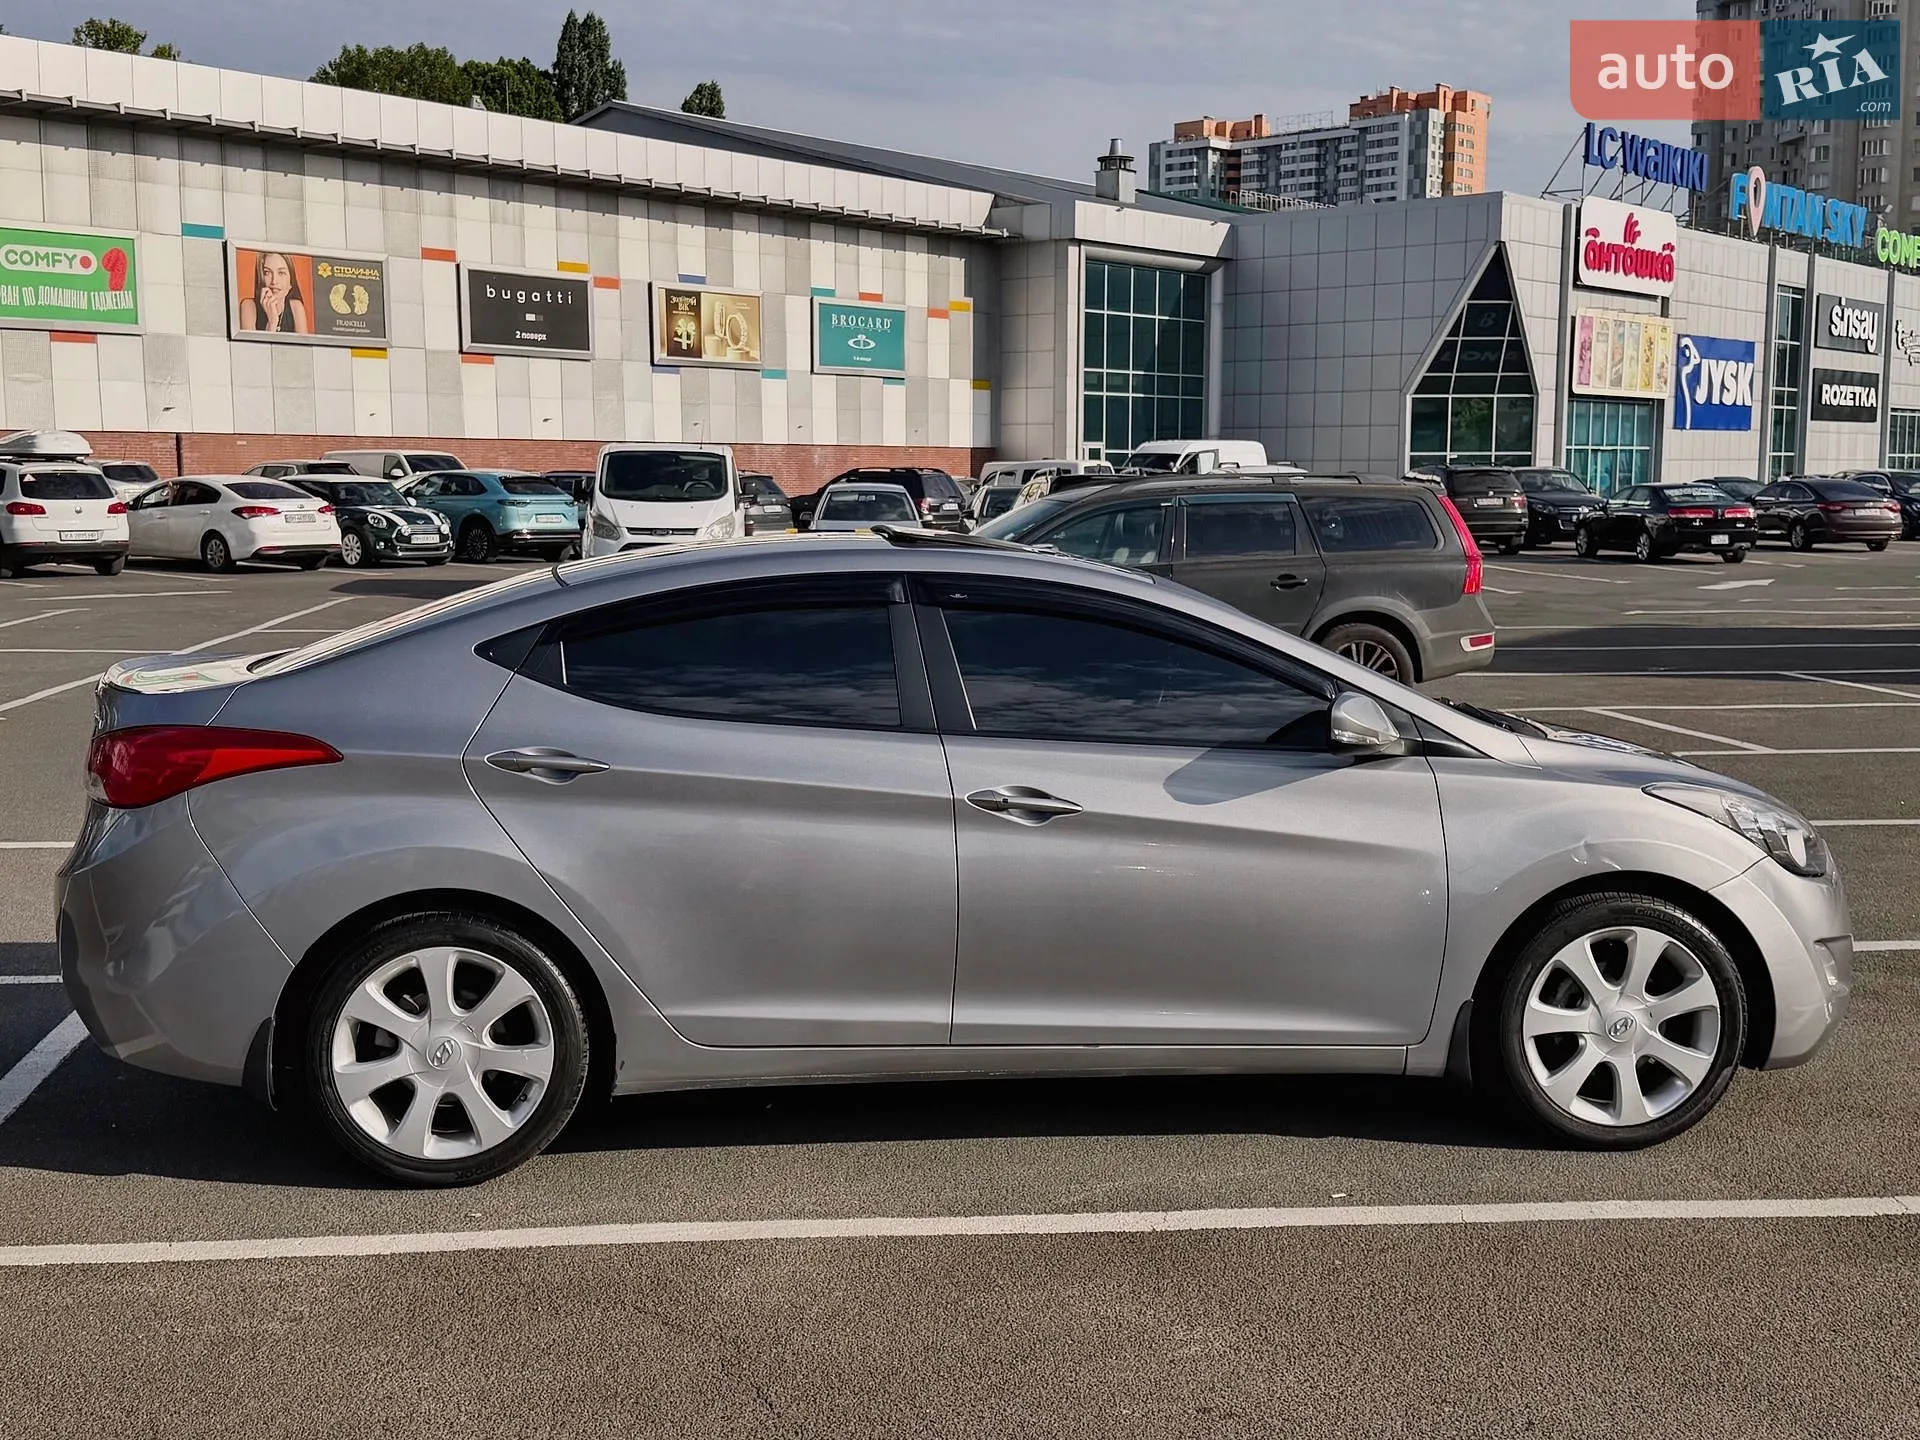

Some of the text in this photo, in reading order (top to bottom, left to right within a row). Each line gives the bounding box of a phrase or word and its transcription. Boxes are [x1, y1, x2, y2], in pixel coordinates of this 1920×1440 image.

[1585, 122, 1618, 170] LC
[1825, 199, 1868, 248] SKY
[4, 249, 77, 269] COMFY
[0, 285, 20, 306] ВАН
[22, 286, 36, 306] ПО
[38, 286, 88, 310] ДОМАШНІМ
[486, 284, 572, 304] bugatti
[831, 313, 891, 329] BROCARD
[1830, 297, 1879, 353] sinsay
[515, 330, 521, 339] 2
[1695, 358, 1754, 407] JYSK
[1822, 383, 1877, 407] ROZETKA
